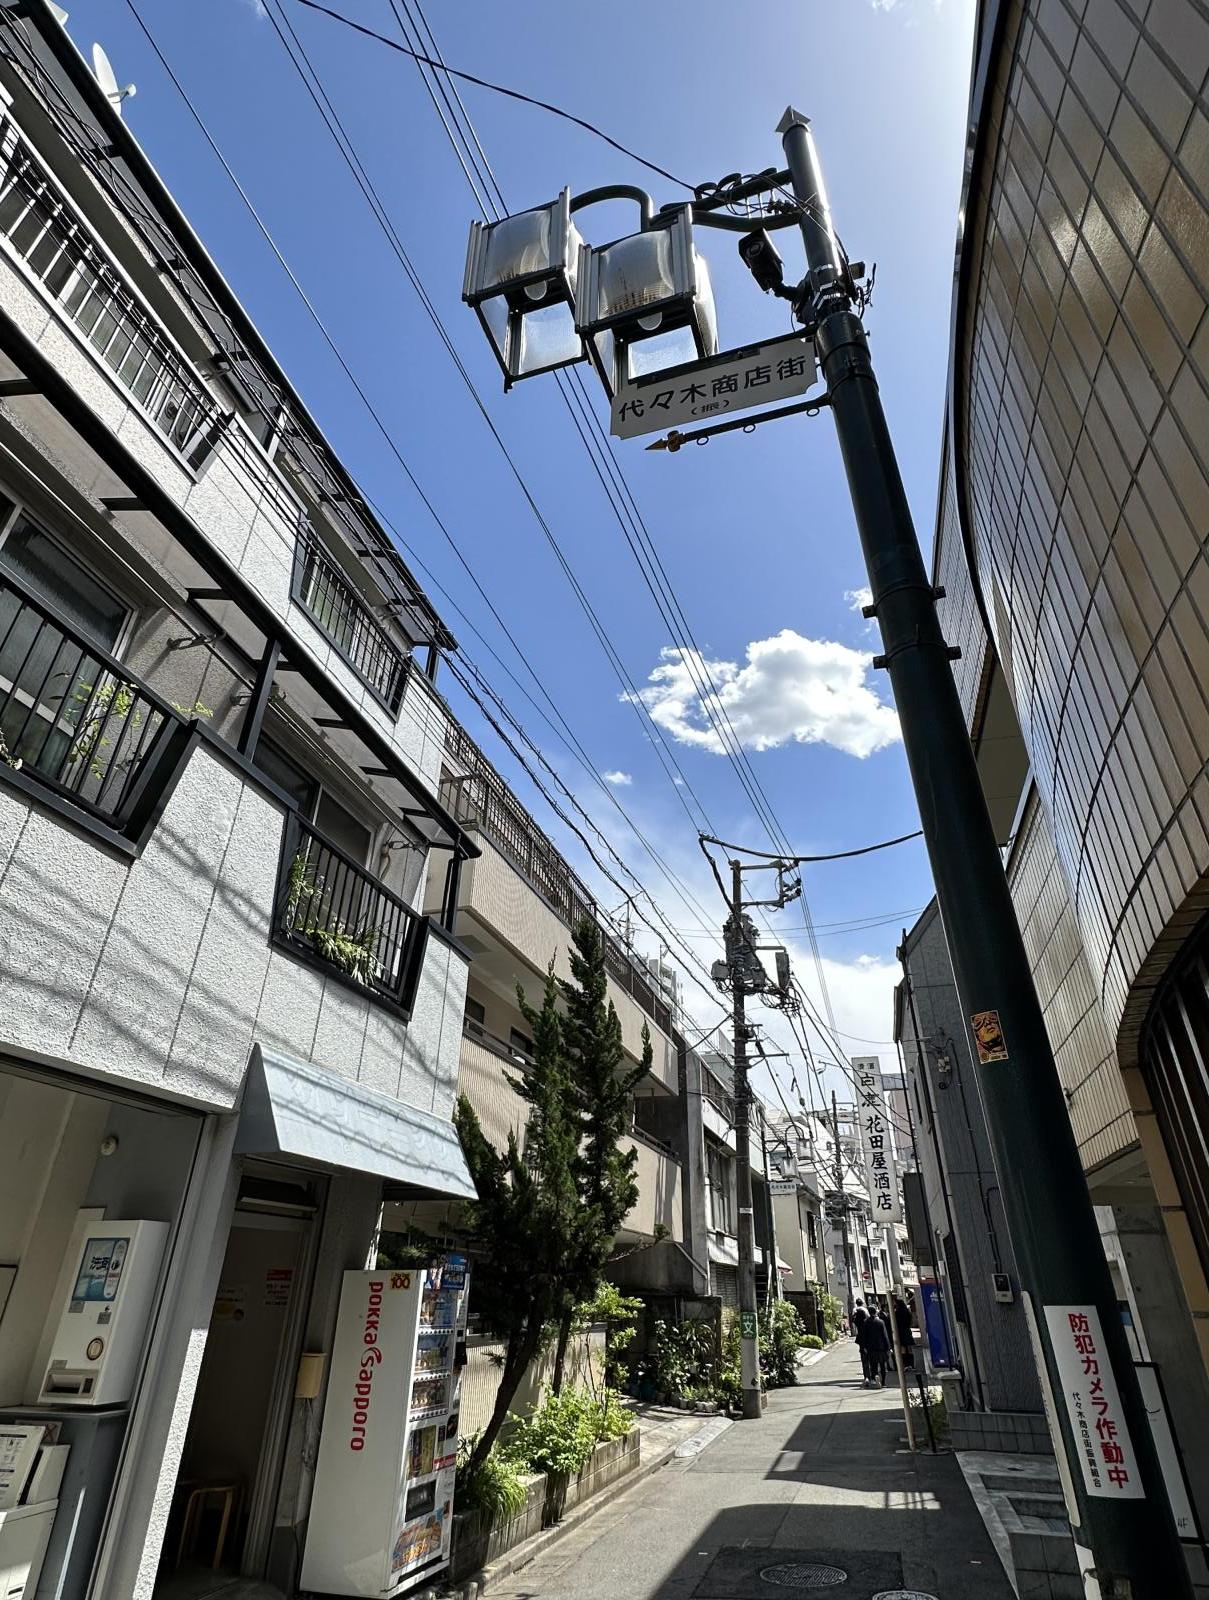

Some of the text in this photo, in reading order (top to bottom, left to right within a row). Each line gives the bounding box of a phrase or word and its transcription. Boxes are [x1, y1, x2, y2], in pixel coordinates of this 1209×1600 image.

[618, 355, 807, 422] 代々木商店街
[865, 1115, 893, 1211] 花田屋酒店
[1068, 1312, 1130, 1489] 防犯カメラ作動中
